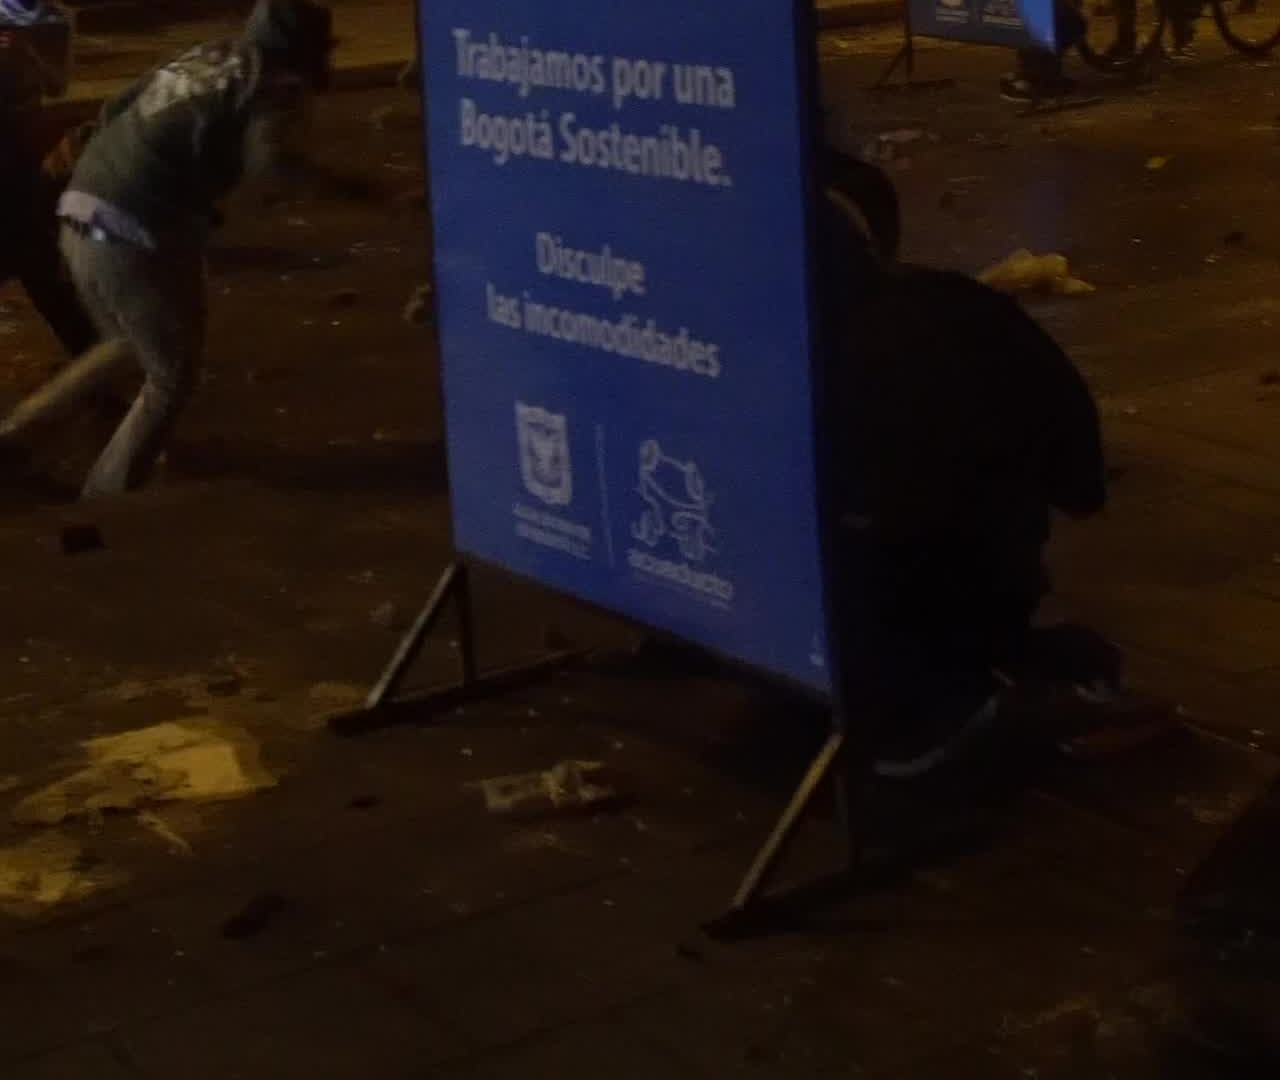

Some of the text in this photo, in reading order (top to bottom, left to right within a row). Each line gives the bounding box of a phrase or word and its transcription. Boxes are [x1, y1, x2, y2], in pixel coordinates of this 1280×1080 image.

[451, 27, 737, 110] Trabajamos por una
[459, 97, 734, 188] Bogotá Sostenible.
[535, 231, 647, 301] Disculpe
[484, 280, 722, 378] las incomodidades
